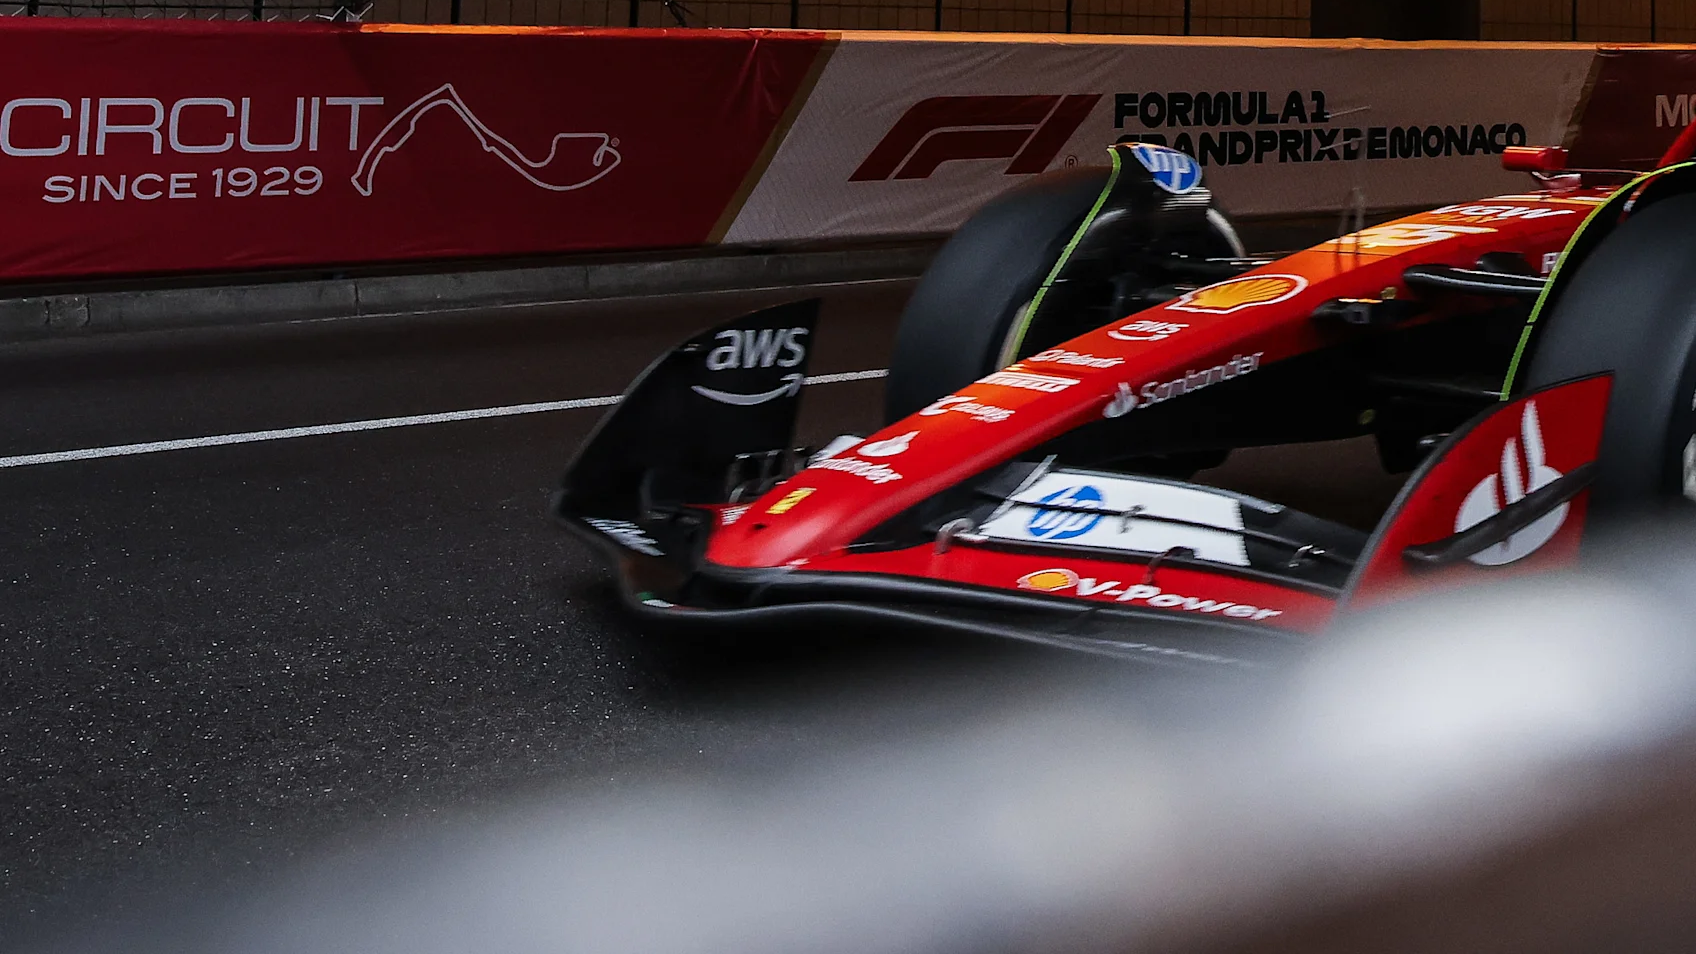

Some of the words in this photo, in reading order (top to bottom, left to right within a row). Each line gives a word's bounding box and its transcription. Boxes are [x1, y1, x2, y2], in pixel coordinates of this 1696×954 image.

[0, 97, 384, 157] CIRCUIT
[42, 173, 198, 204] SINCE
[212, 166, 323, 198] 1929
[706, 327, 809, 371] aws
[1121, 320, 1190, 337] aws
[1136, 351, 1264, 409] Santander
[1076, 578, 1283, 620] V-Power
